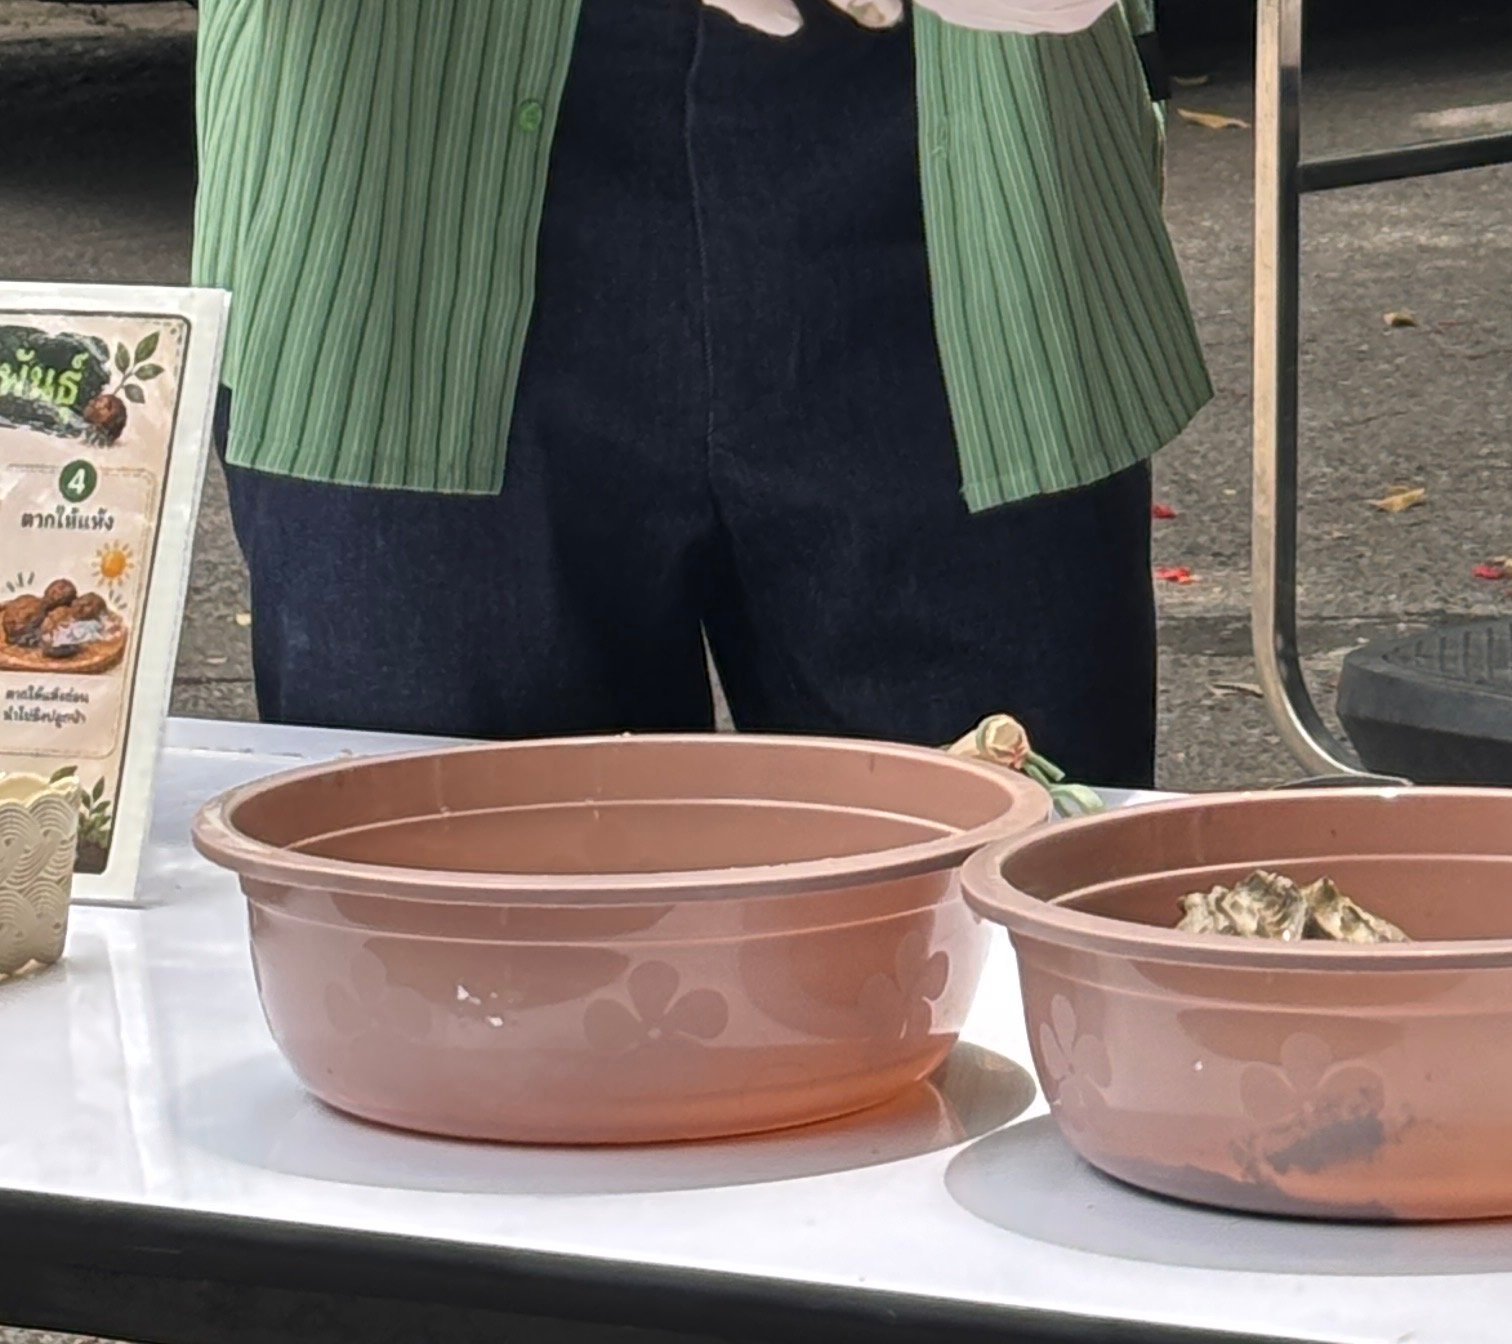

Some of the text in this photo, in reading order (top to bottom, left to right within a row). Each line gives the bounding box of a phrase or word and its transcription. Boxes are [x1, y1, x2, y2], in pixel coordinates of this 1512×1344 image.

[67, 467, 86, 495] 4
[21, 504, 115, 532] ตากให้แห้ง
